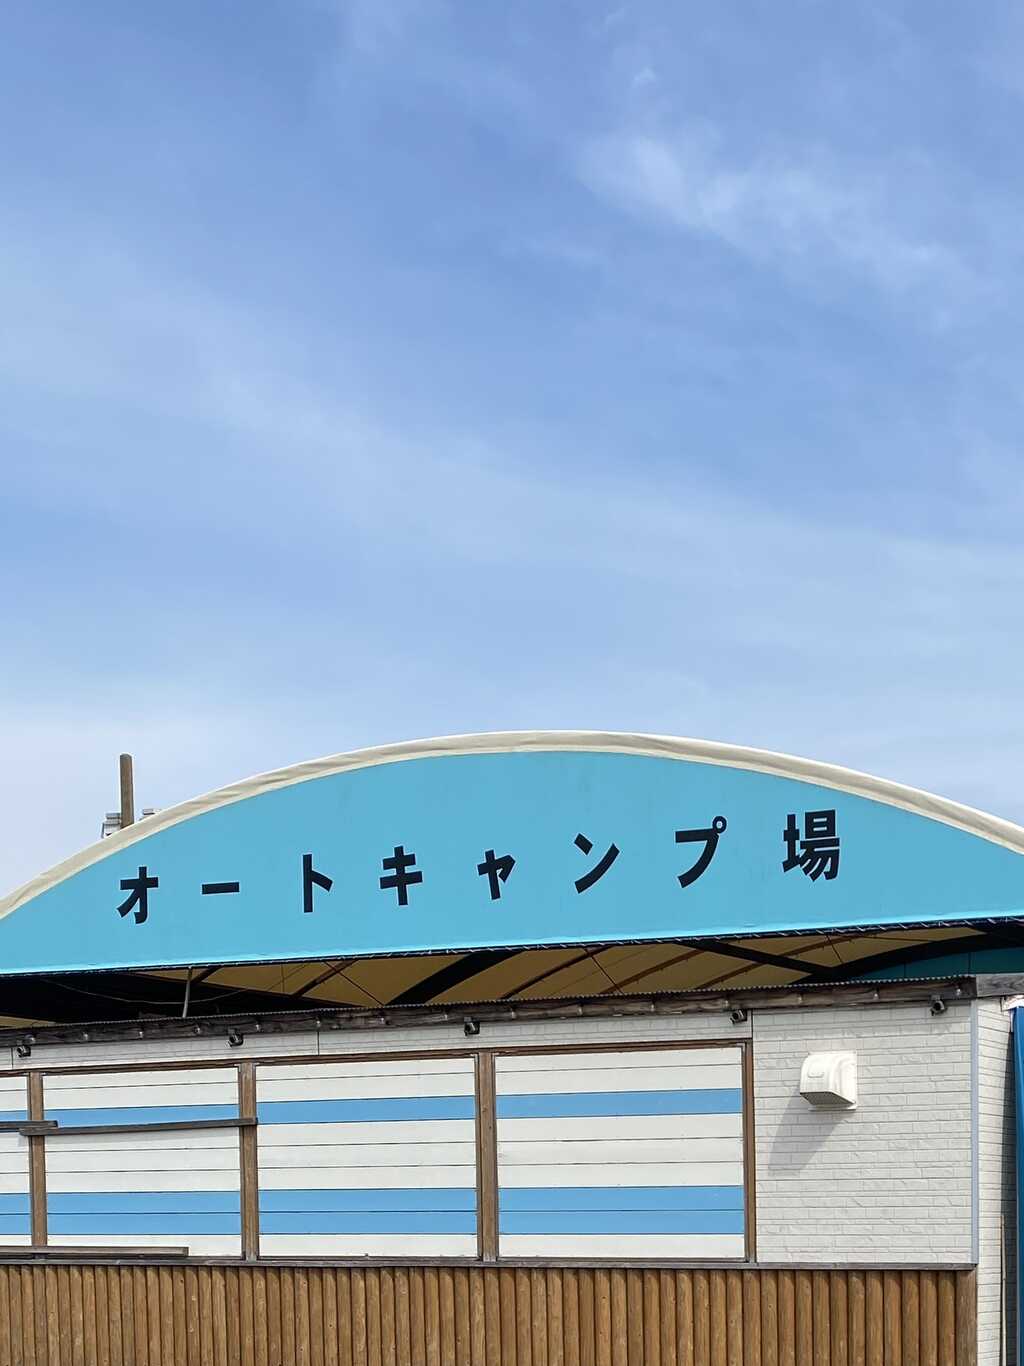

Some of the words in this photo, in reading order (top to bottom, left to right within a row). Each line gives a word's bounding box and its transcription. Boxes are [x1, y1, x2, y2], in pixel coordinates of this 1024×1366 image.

[117, 809, 841, 925] オートキャンプ場
